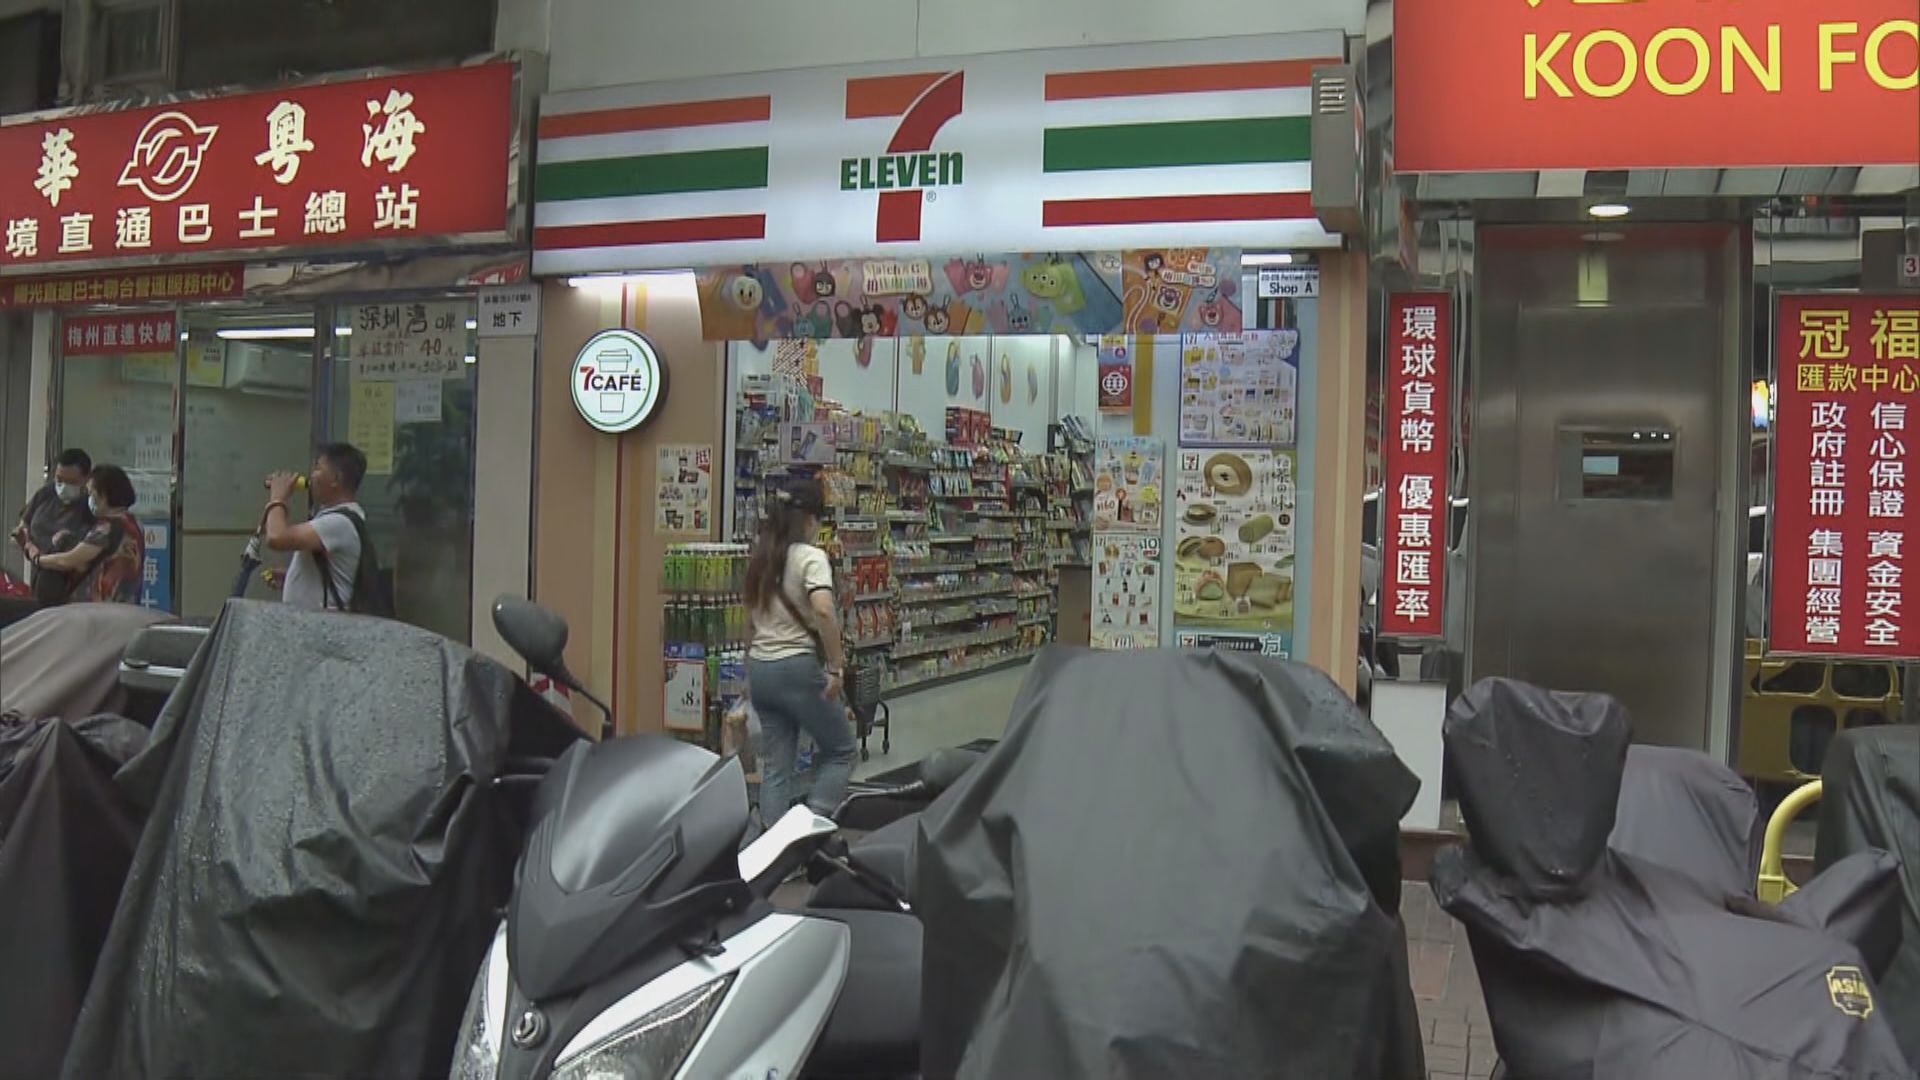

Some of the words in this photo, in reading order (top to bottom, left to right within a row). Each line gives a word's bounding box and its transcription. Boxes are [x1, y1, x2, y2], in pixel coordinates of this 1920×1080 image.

[1524, 24, 1781, 99] KOON
[1818, 20, 1919, 92] FO
[34, 127, 80, 207] 華
[254, 87, 426, 185] 粵海
[846, 70, 964, 243] 7
[5, 183, 420, 259] 境直通巴士總站
[1905, 257, 1917, 274] 3
[492, 311, 522, 328] 地下
[1269, 281, 1298, 295] Shop
[1304, 280, 1313, 294] A
[1799, 308, 1920, 360] 冠福
[1400, 305, 1437, 454] 環球貨幣
[1797, 362, 1920, 393] 匯款中心
[1809, 401, 1848, 516] 政府註冊
[1868, 401, 1908, 518] 信心保證
[1394, 473, 1434, 624] 優惠匯率
[1805, 528, 1844, 644] 集團經營
[1864, 529, 1904, 646] 資金安全
